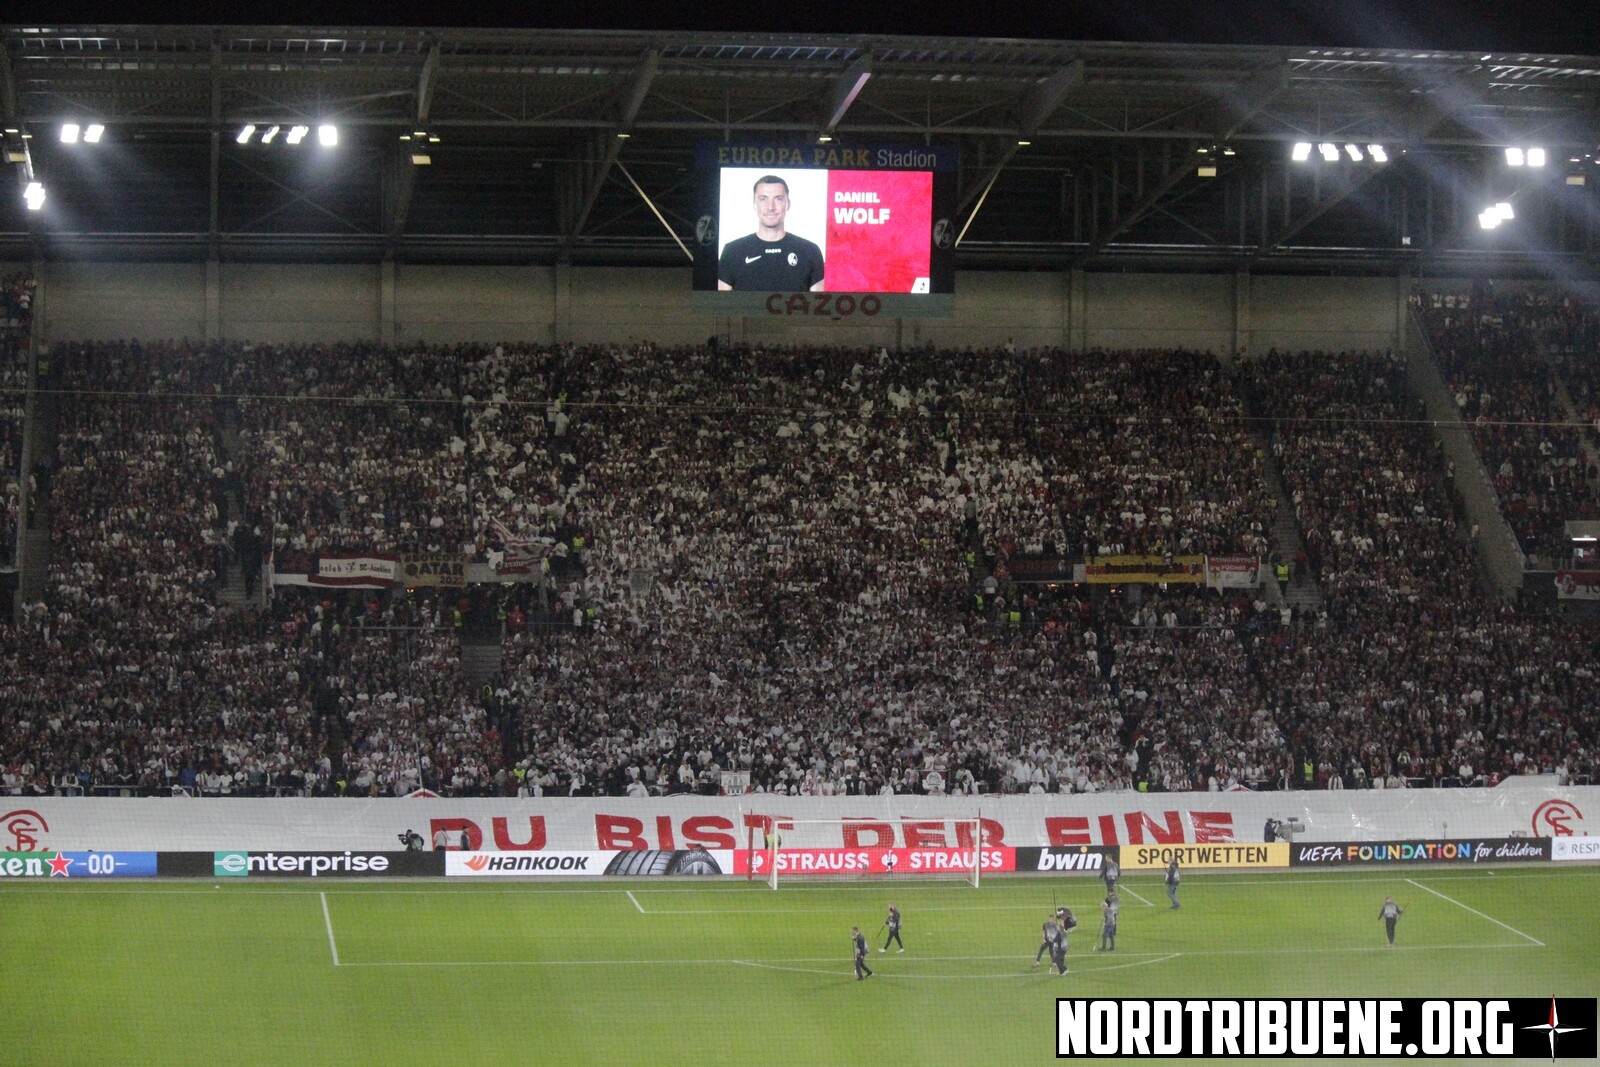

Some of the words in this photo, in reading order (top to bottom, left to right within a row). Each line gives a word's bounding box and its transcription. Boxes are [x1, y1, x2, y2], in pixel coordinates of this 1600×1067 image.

[718, 146, 804, 165] EUROPA
[814, 148, 870, 167] PARK
[877, 149, 937, 168] Stadion
[834, 191, 881, 204] DANIEL
[833, 207, 891, 225] WOLF
[765, 293, 882, 316] CAZOO
[430, 815, 546, 851] DU
[595, 813, 794, 851] BIST
[841, 816, 1005, 849] DER
[1045, 811, 1236, 846] EINE
[775, 852, 870, 870] STRAUSS
[909, 851, 1003, 869] STRAUSS
[1038, 846, 1103, 871] bwin
[1137, 846, 1268, 865] SPORTWETTEN
[1299, 846, 1343, 861] UEFA
[1347, 842, 1471, 861] FOUNDATION
[1473, 842, 1493, 863] for
[1495, 842, 1543, 858] children
[222, 851, 389, 876] enterprise
